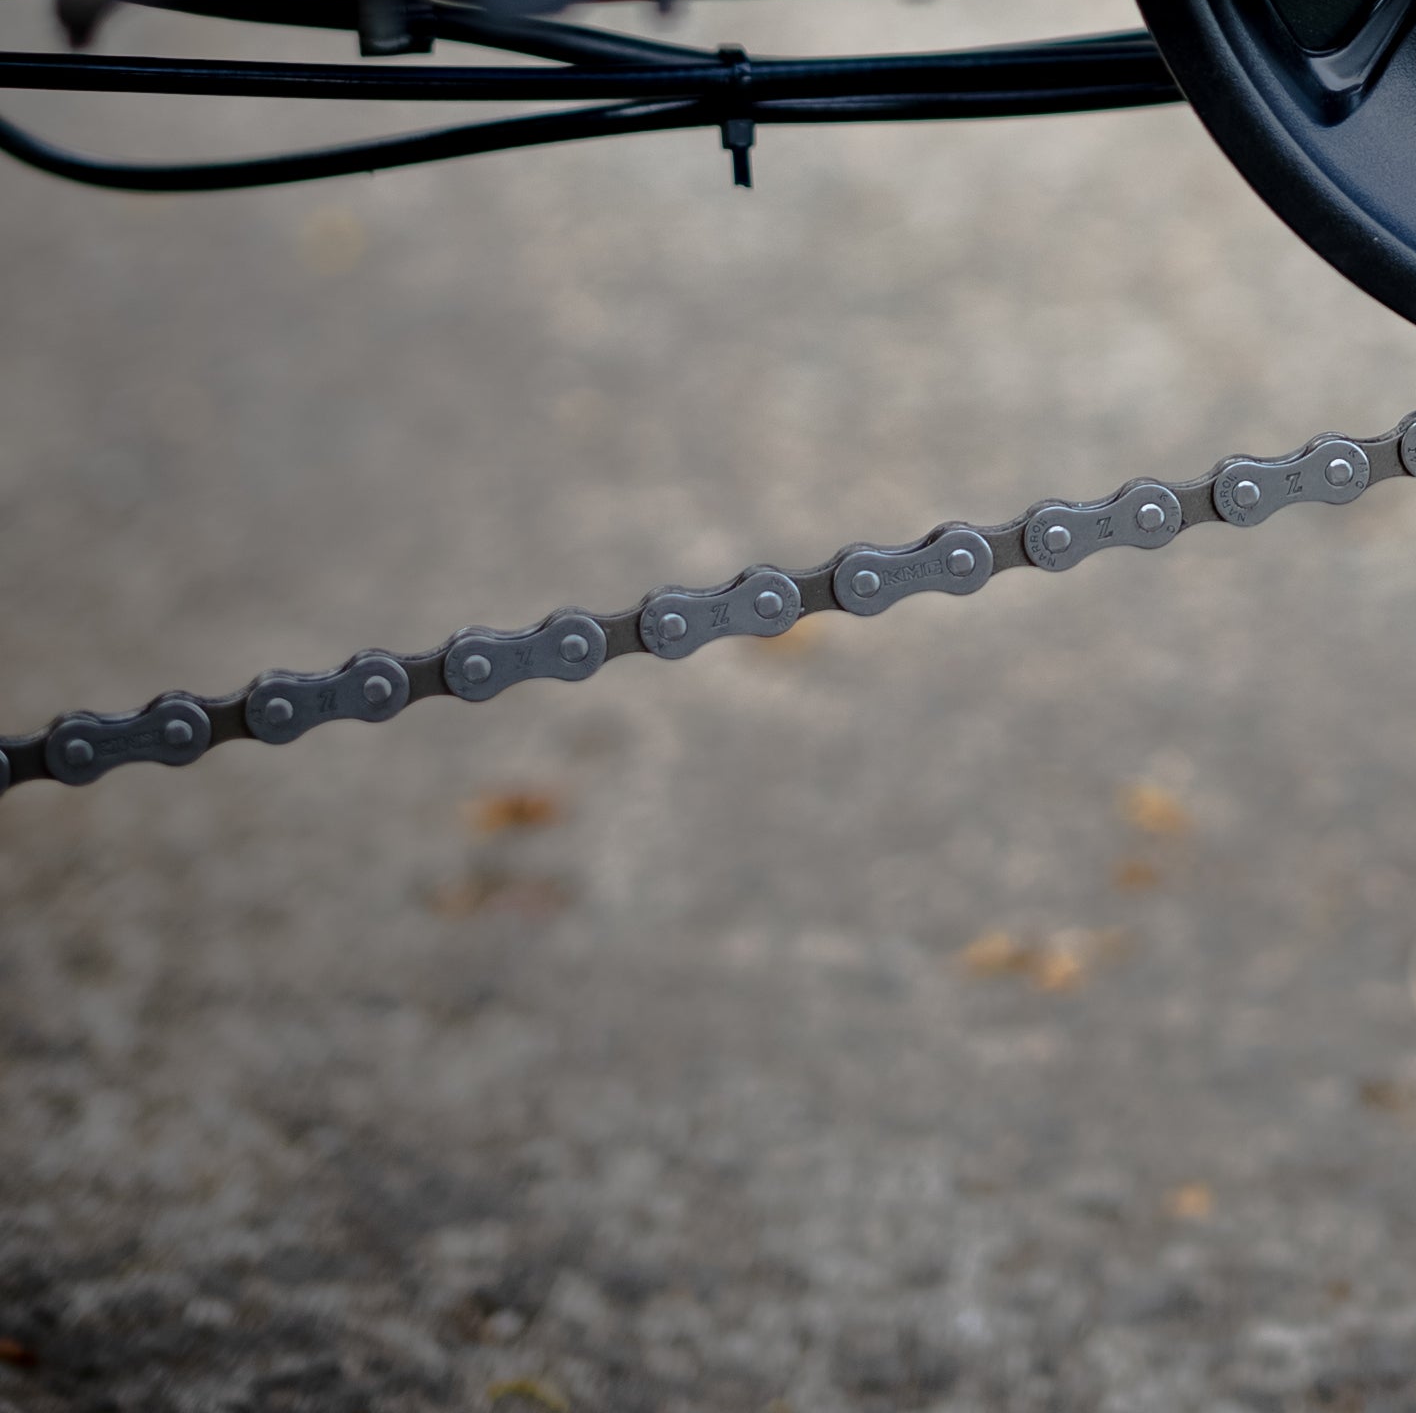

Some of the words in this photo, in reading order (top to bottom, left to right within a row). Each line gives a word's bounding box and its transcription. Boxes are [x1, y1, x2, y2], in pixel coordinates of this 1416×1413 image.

[1284, 471, 1304, 496] Z
[1095, 515, 1115, 540] Z
[881, 558, 944, 586] KMC
